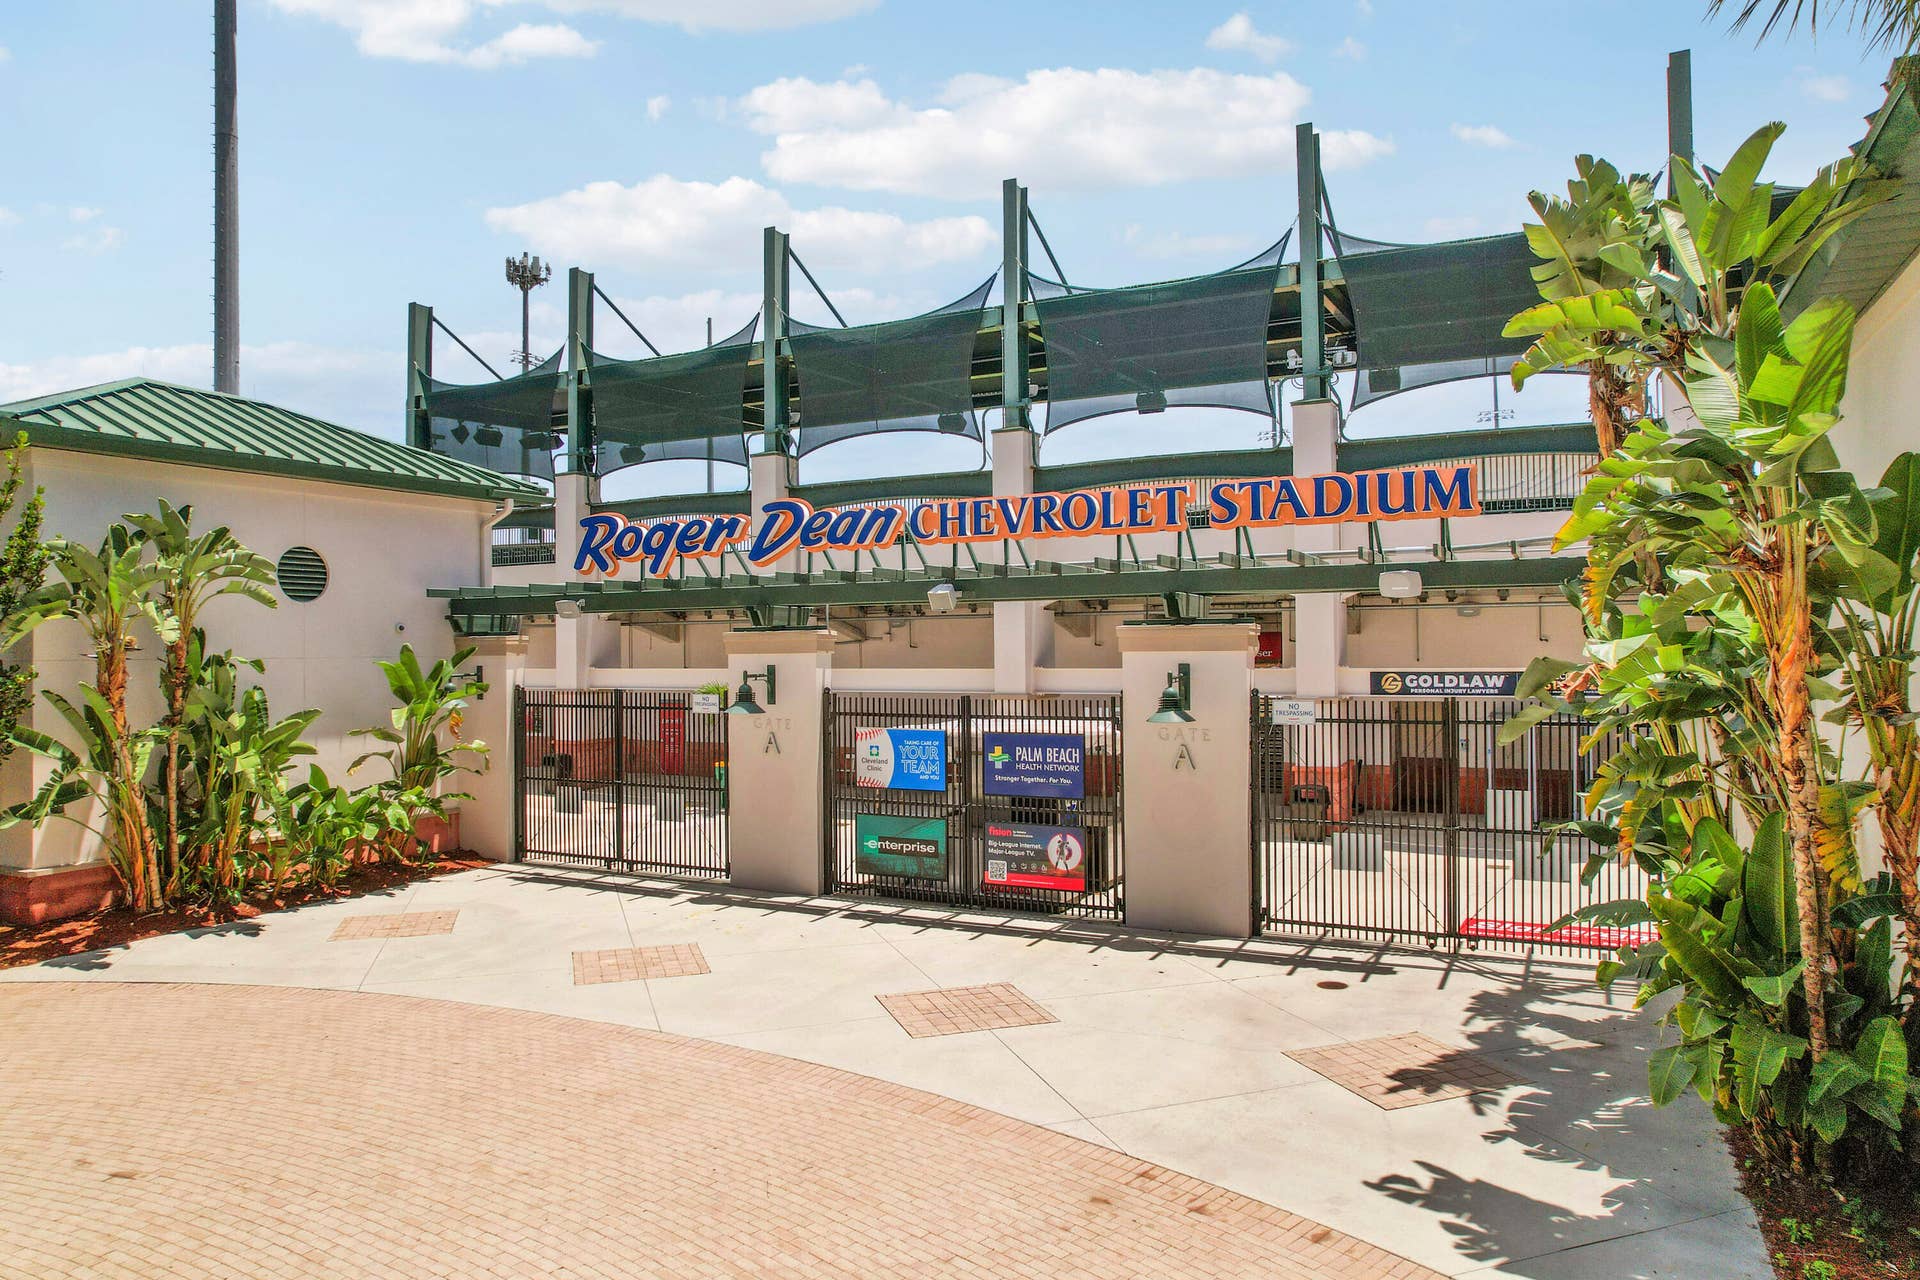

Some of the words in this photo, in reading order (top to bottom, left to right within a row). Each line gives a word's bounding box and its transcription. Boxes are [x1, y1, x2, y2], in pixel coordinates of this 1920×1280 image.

[573, 512, 748, 577] Roger
[748, 498, 906, 566] Dean
[909, 483, 1191, 541] CHEVROLET
[1209, 465, 1478, 525] STADIUM
[1405, 674, 1505, 688] GOLDLAW
[753, 717, 792, 730] GATE
[1158, 727, 1212, 742] GATE
[764, 731, 782, 755] A
[899, 745, 939, 760] YOUR
[1015, 746, 1043, 762] PALM
[1046, 747, 1080, 763] BEACH
[1174, 743, 1197, 770] A
[861, 757, 889, 765] Cleveland
[901, 760, 940, 775] TEAM
[1015, 762, 1042, 771] HEALTH
[1043, 763, 1080, 772] NETWORK
[994, 774, 1020, 783] Stronger
[1020, 775, 1048, 784] Together.
[865, 839, 936, 854] enterprise
